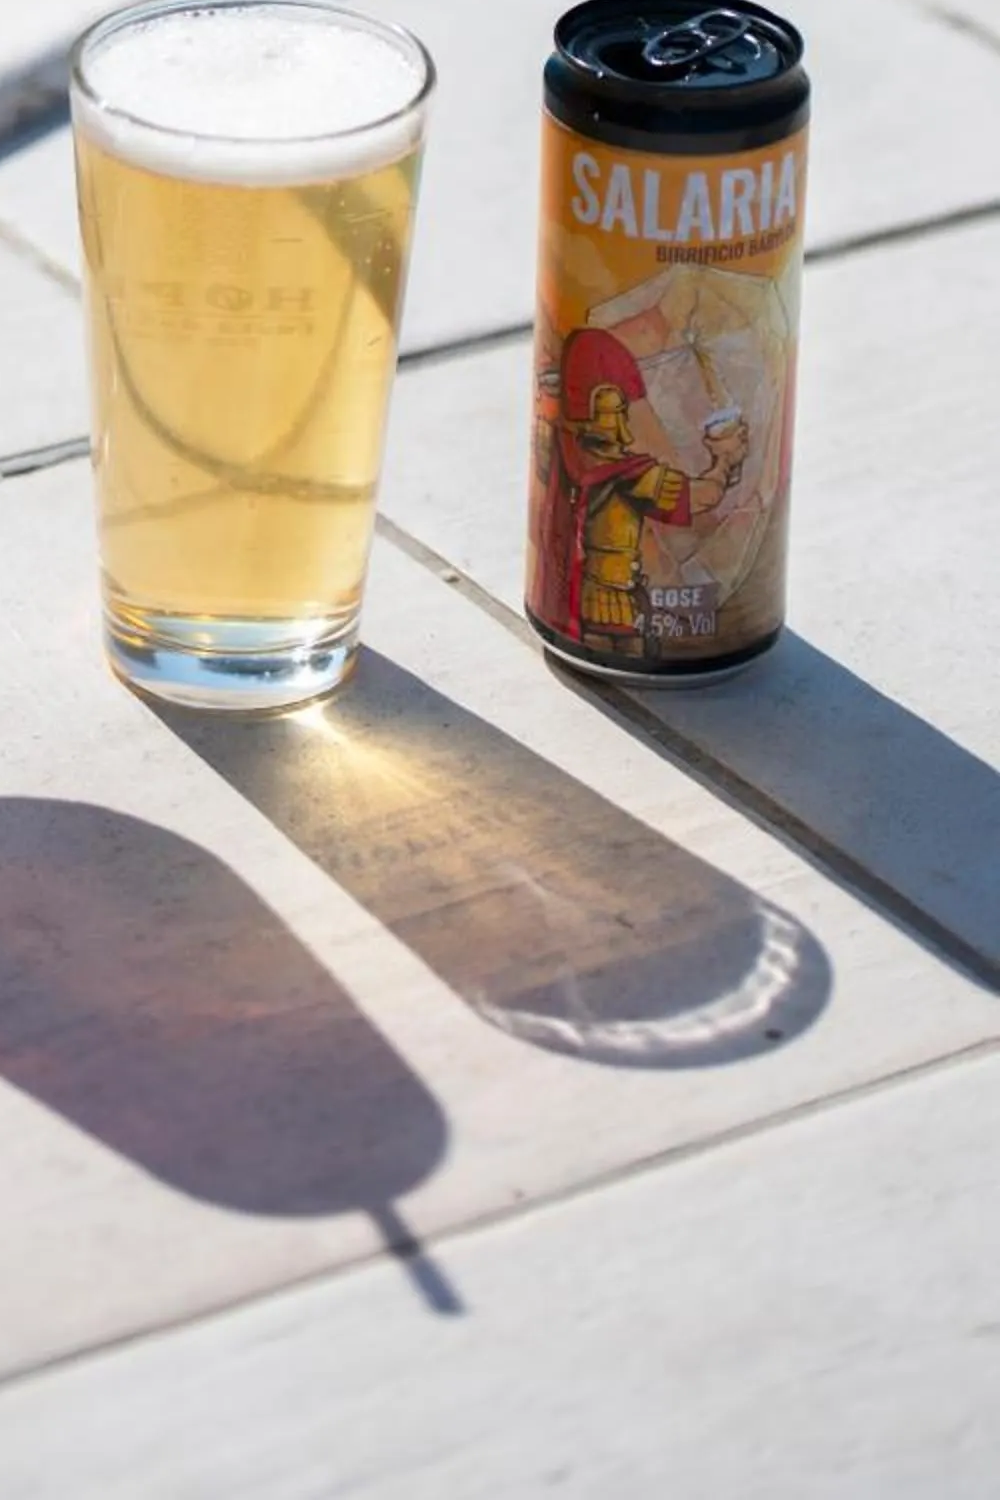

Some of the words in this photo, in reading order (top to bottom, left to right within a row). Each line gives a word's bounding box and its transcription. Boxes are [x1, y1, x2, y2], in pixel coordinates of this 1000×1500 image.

[572, 152, 797, 242] SALARIA
[651, 587, 703, 608] GOSE
[689, 610, 717, 637] Vol
